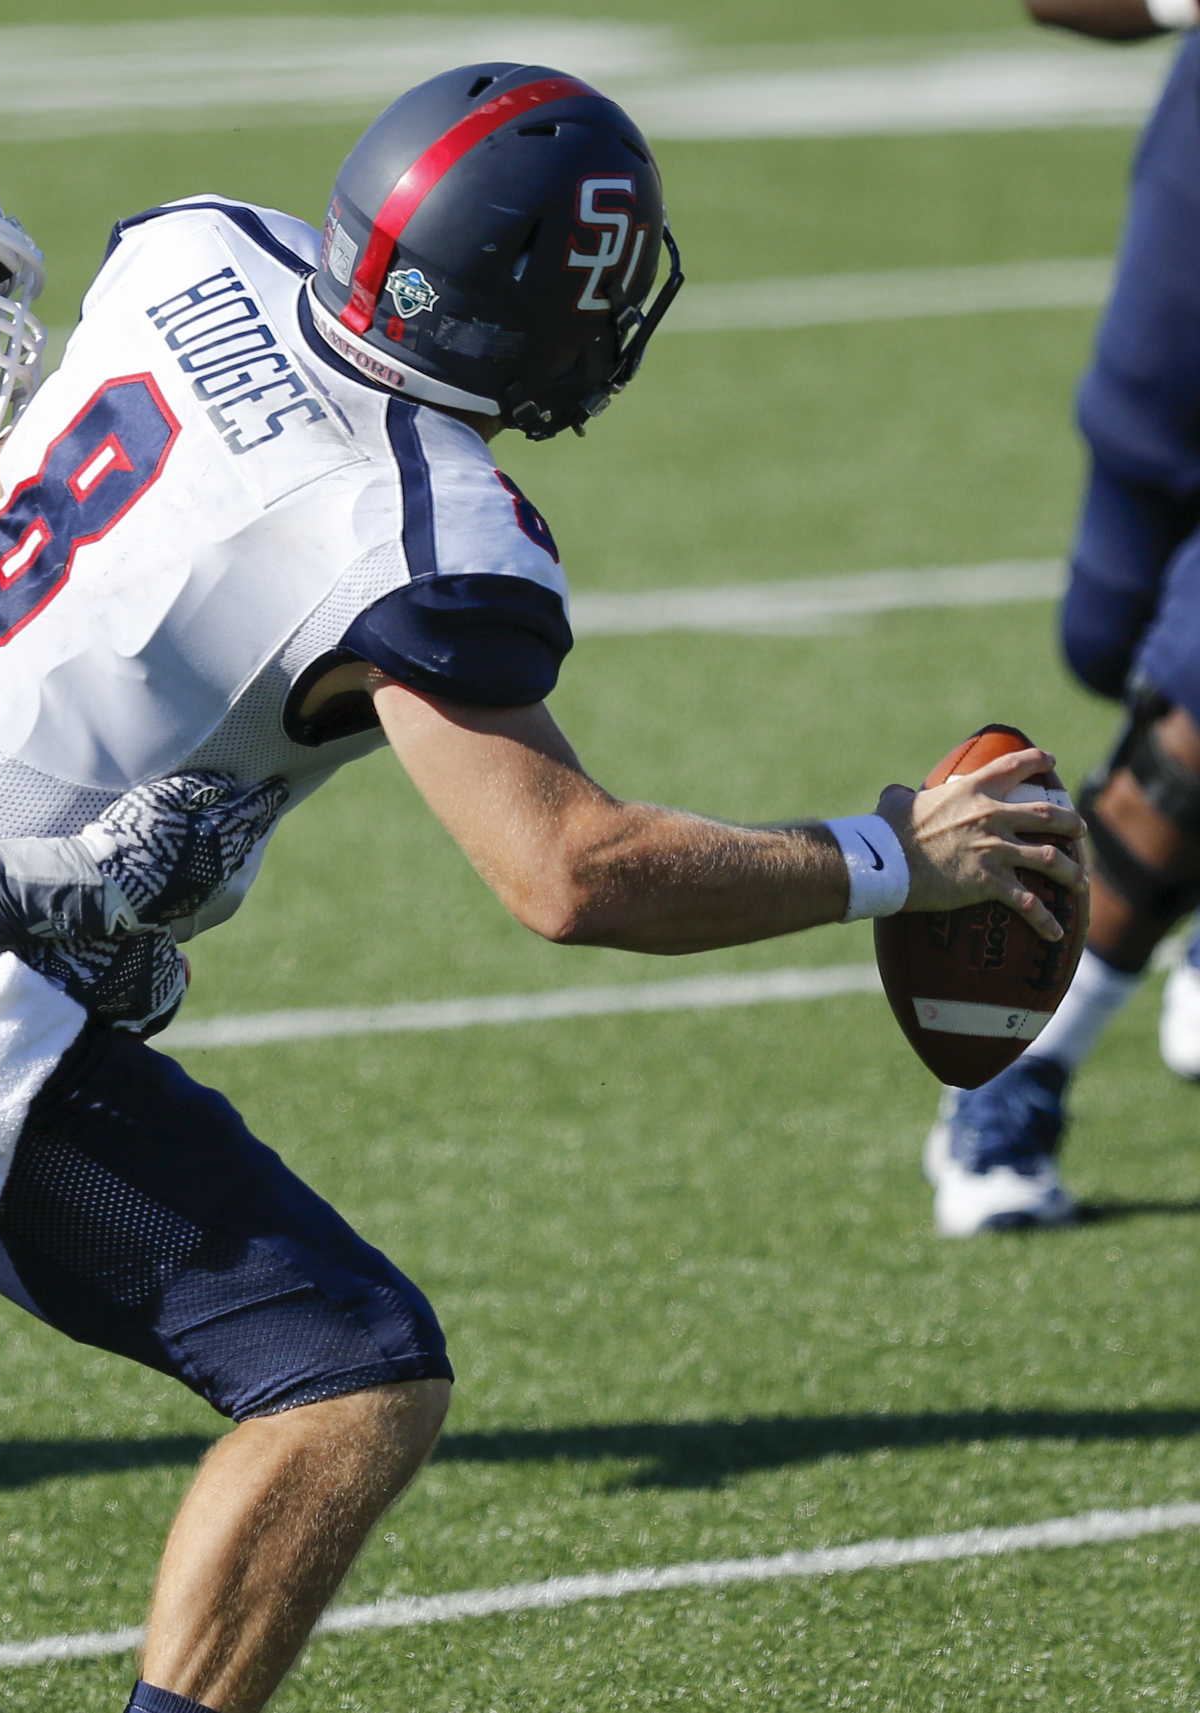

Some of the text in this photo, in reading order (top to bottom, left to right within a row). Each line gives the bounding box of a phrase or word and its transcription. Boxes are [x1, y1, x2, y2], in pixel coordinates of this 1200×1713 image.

[394, 280, 428, 302] FCS
[386, 316, 405, 343] 8
[145, 266, 327, 456] HODGES
